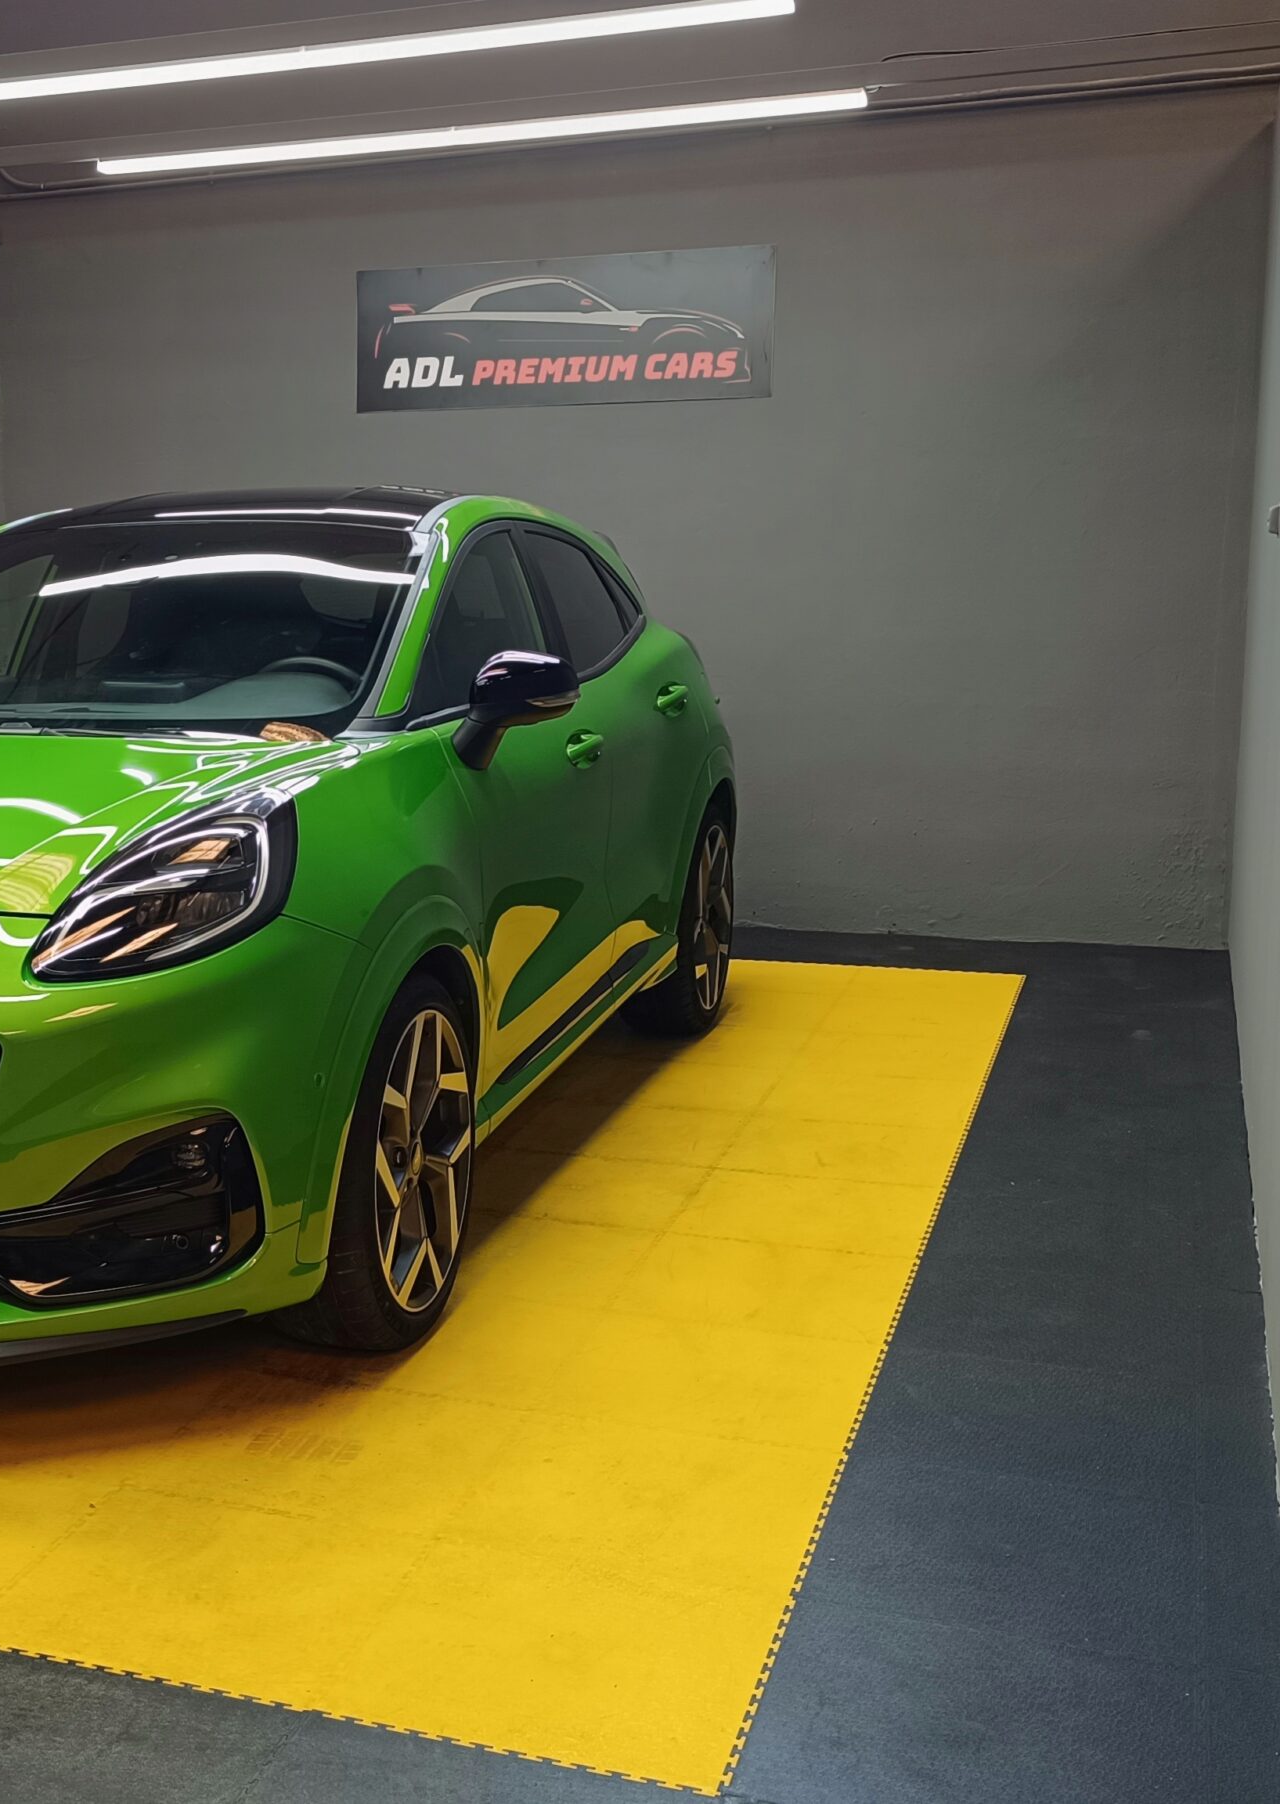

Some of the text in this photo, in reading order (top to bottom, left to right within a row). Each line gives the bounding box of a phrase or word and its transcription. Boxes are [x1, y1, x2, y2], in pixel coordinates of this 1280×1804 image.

[383, 351, 738, 389] ADL PREMIUM CARS
